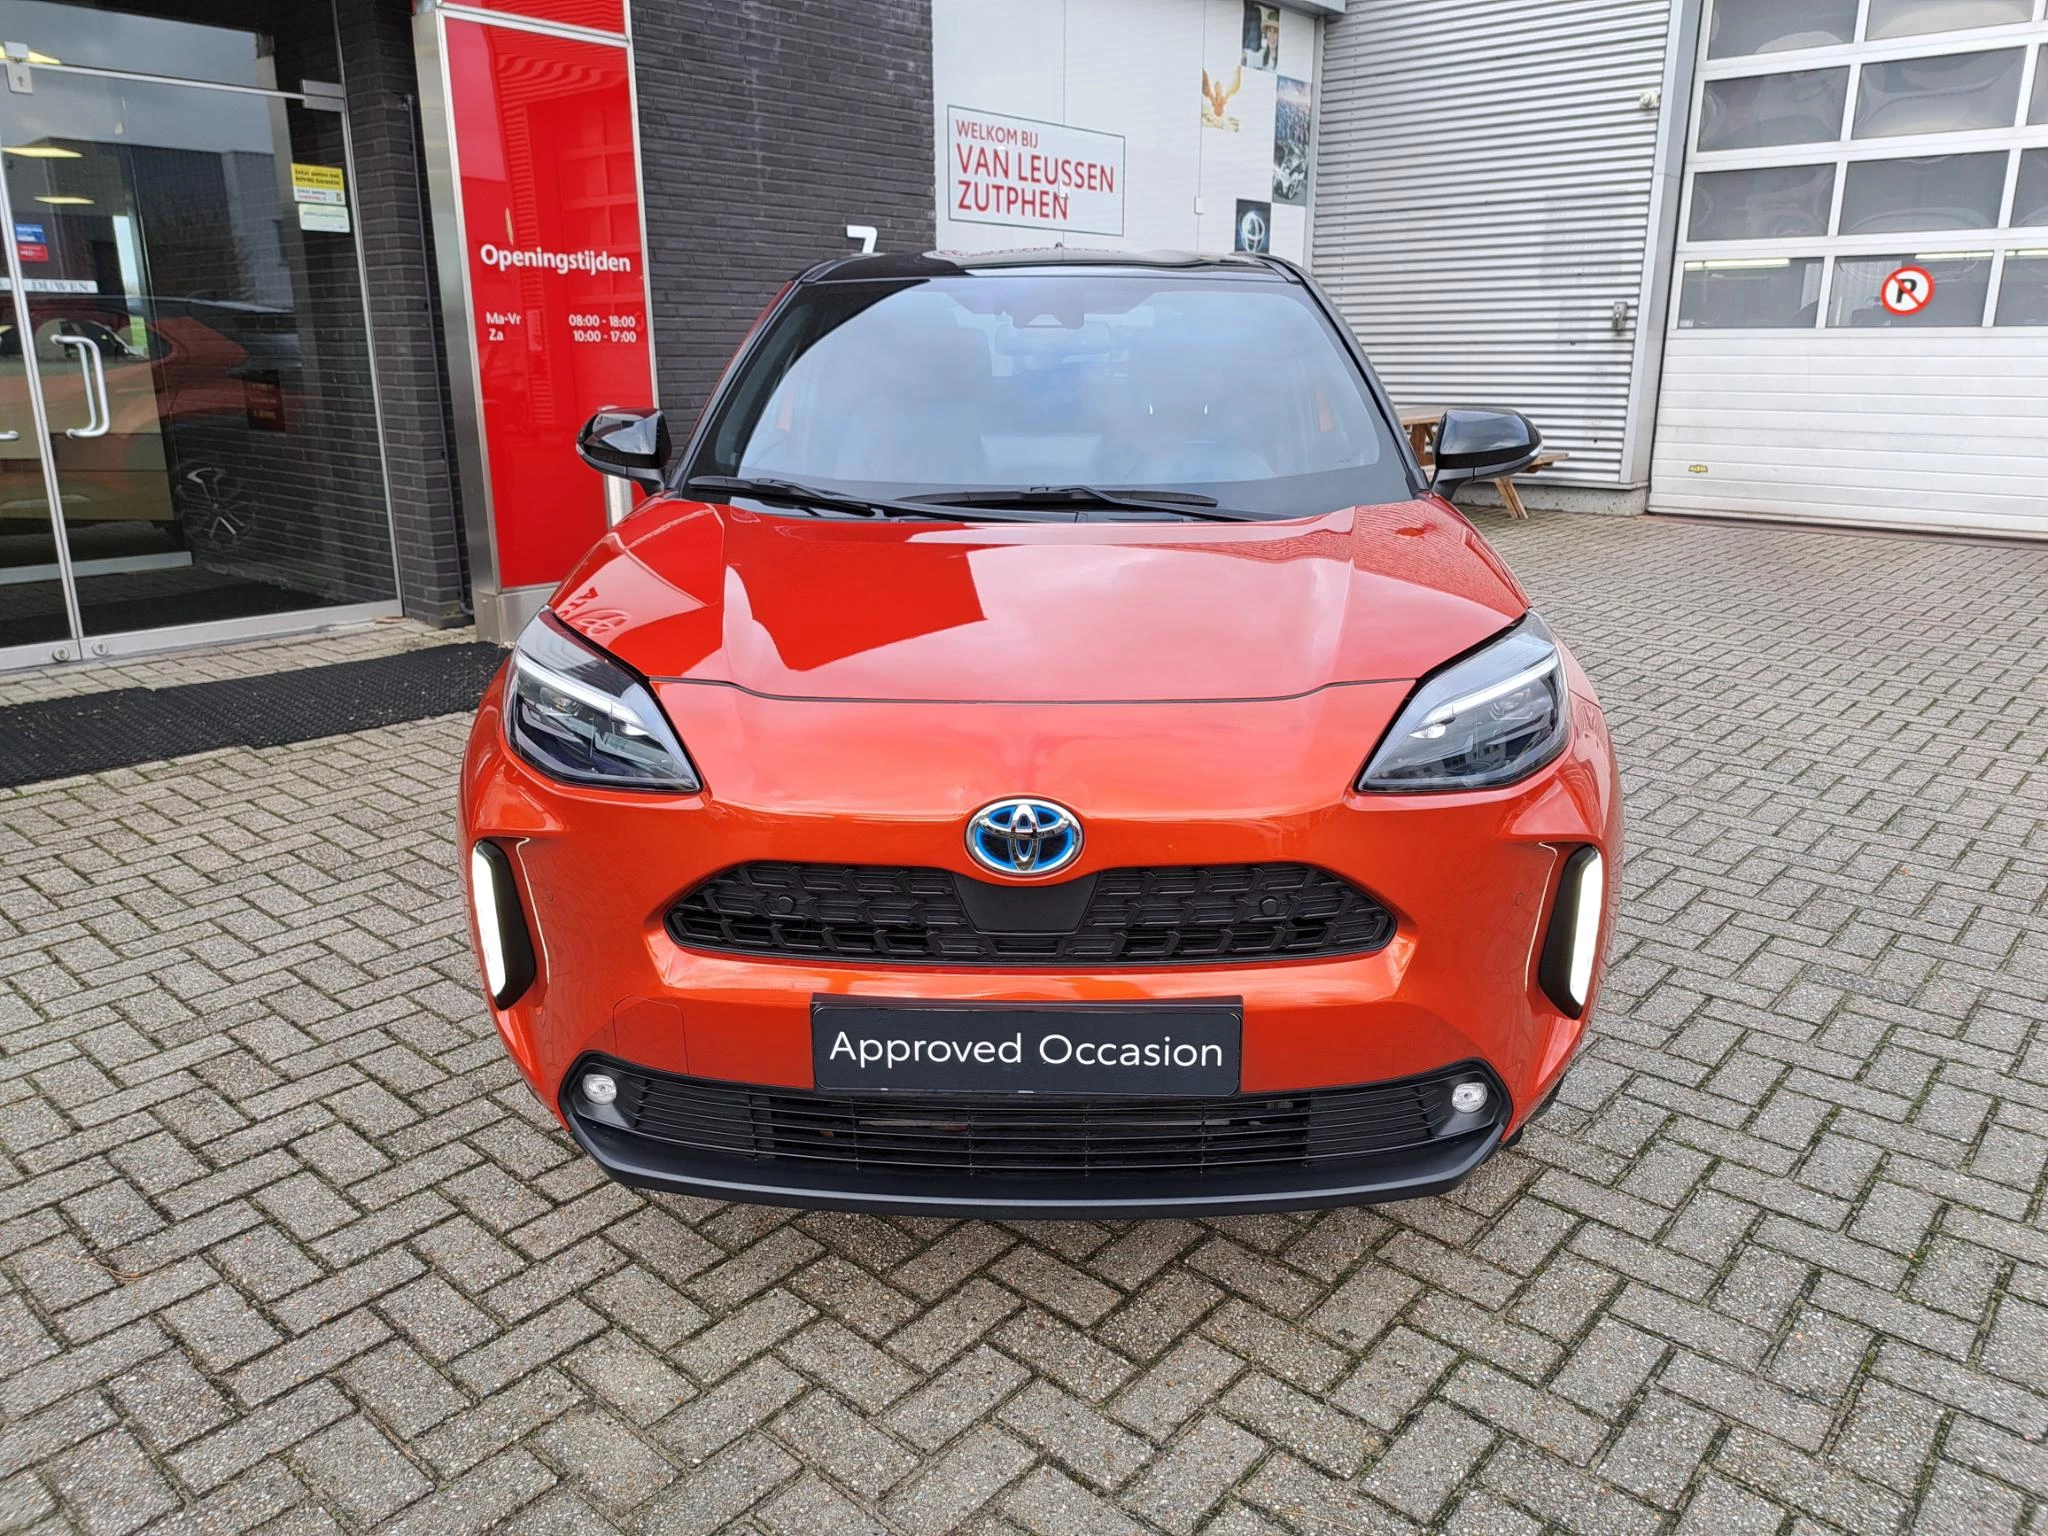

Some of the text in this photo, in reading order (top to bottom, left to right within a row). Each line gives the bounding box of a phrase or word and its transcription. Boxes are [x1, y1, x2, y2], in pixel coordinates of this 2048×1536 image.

[956, 119, 1039, 148] WELKOM BIJ
[956, 143, 1114, 193] VAN LEUSSEN
[958, 179, 1069, 220] ZUTPHEN
[846, 224, 878, 254] 7
[480, 243, 631, 276] Openingstijden
[1896, 278, 1918, 304] P
[485, 311, 521, 325] Ma-Vr
[568, 314, 600, 327] 08:00
[608, 315, 636, 328] 18:00
[488, 328, 504, 341] Za
[573, 330, 601, 342] 10:00
[610, 331, 637, 343] 17:00
[829, 1031, 1222, 1069] Approved Occasion
